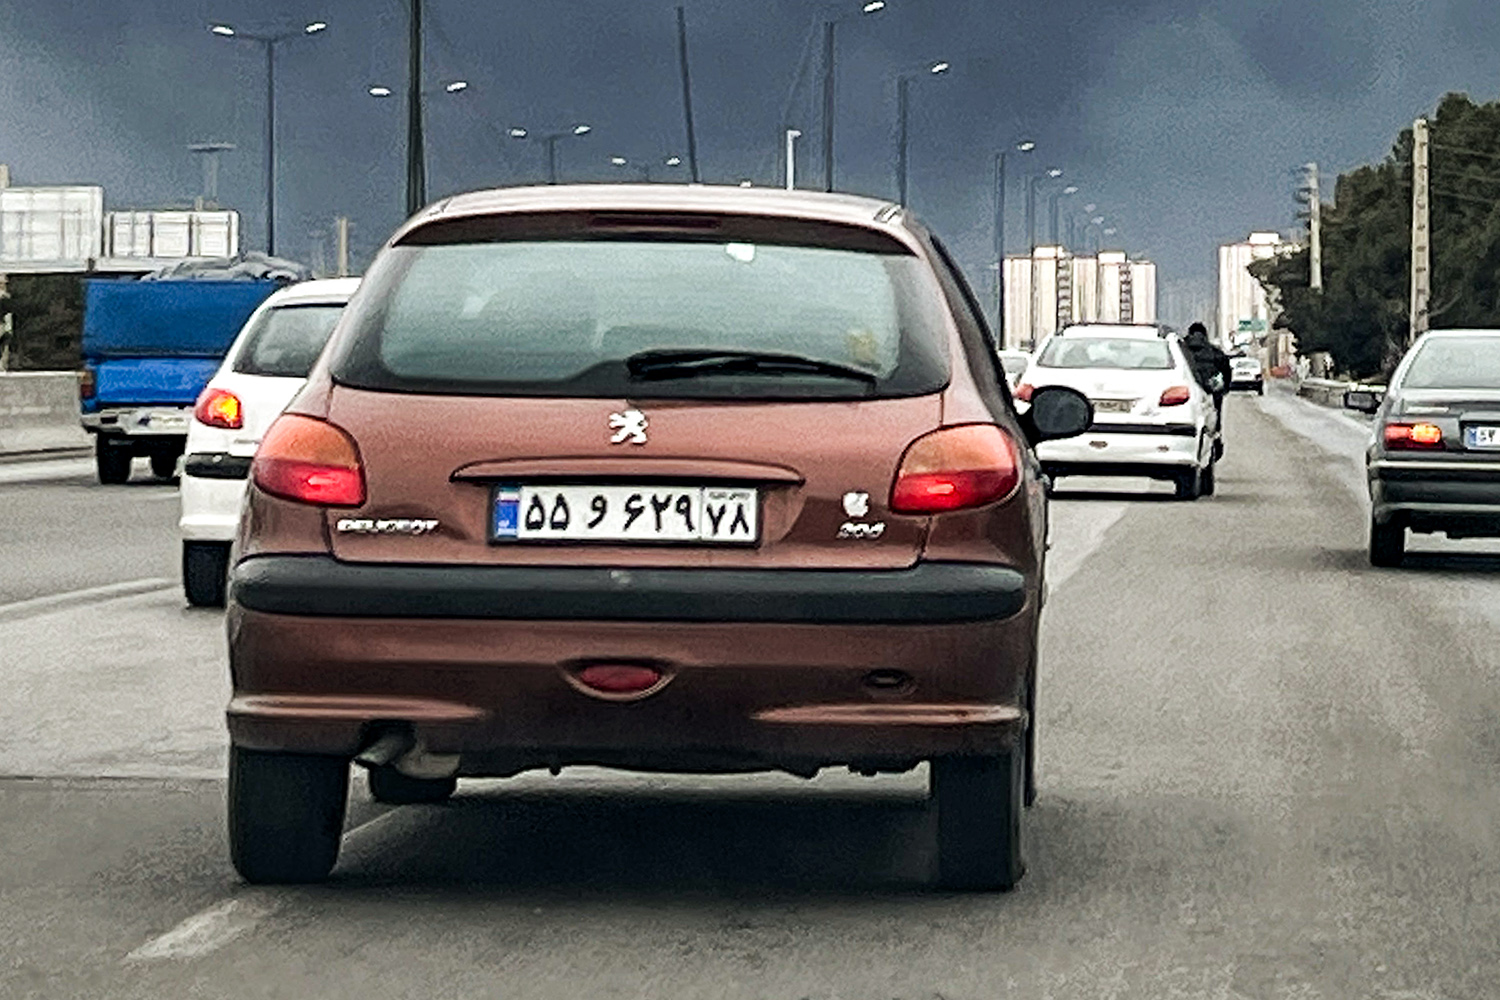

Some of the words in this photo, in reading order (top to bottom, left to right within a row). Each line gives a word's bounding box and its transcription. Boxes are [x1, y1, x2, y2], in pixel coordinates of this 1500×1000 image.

[525, 493, 569, 531] ۵۵
[587, 495, 607, 530] و
[623, 493, 696, 533] ۶۲۹
[706, 503, 751, 536] ۷۸
